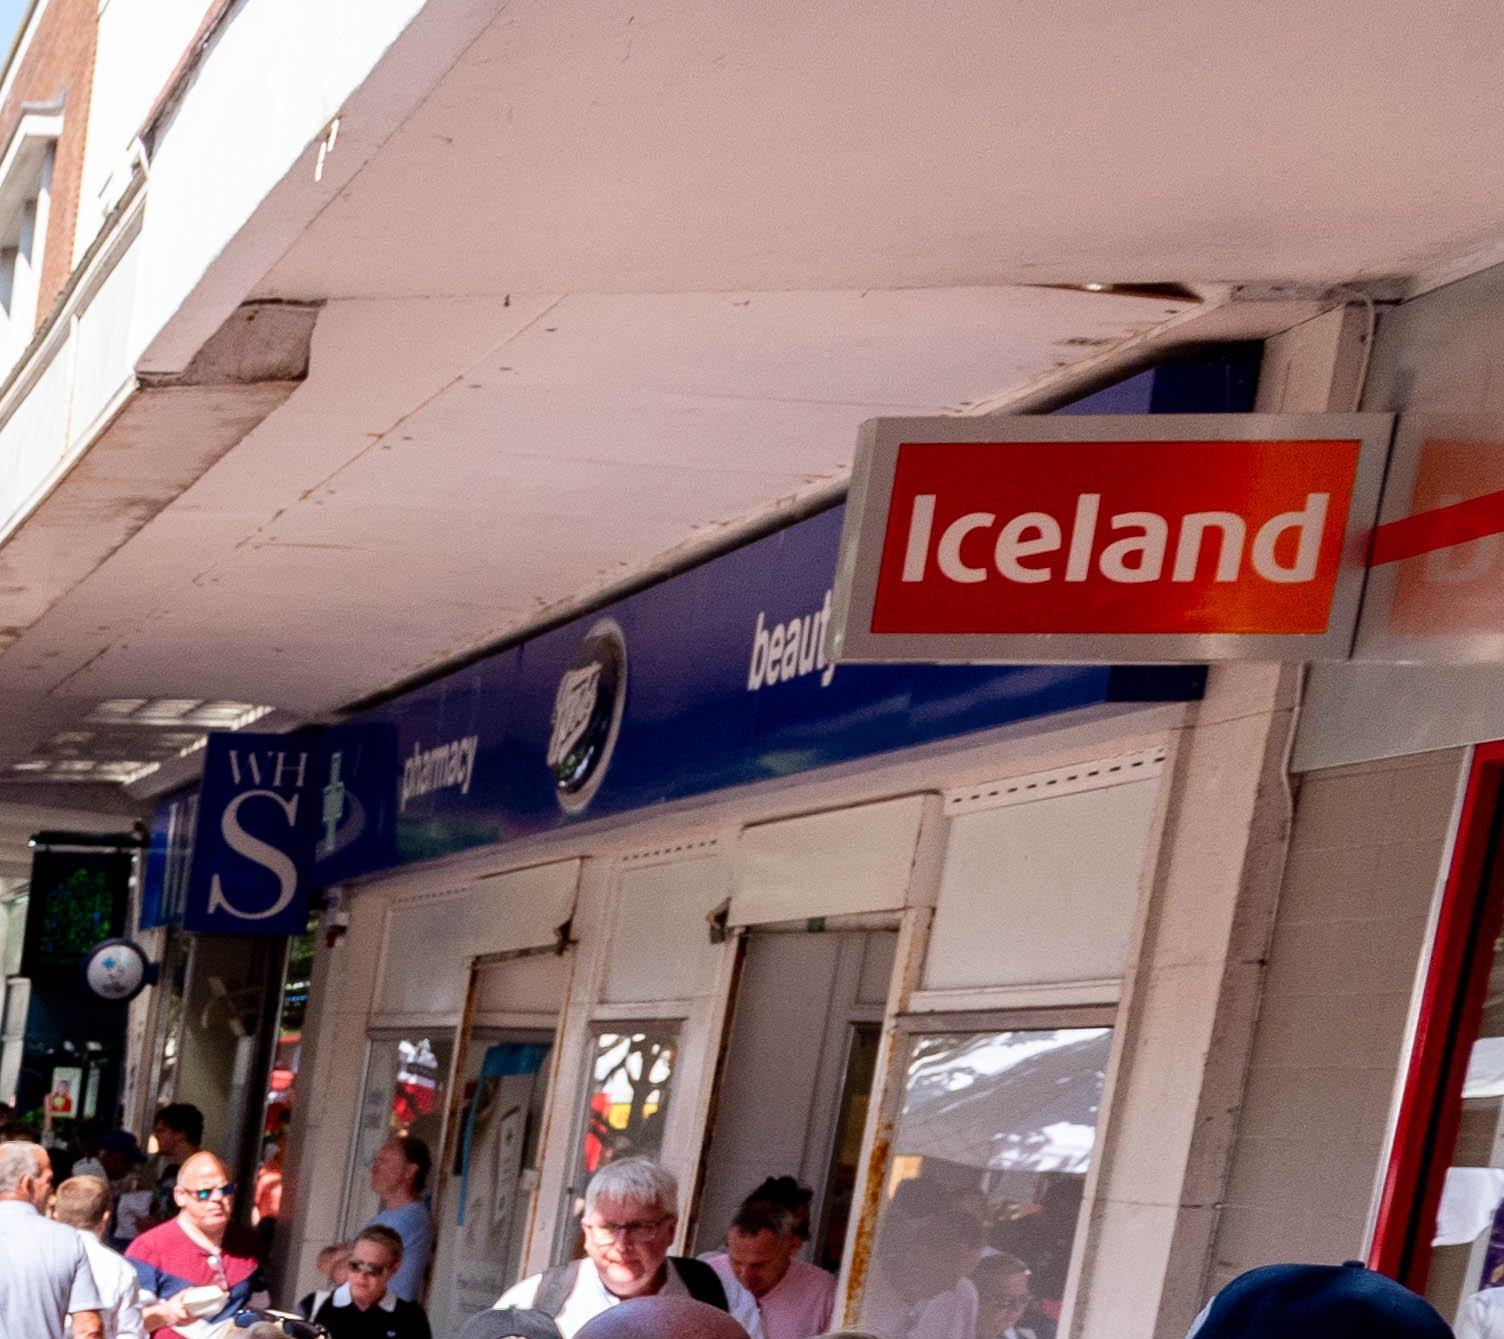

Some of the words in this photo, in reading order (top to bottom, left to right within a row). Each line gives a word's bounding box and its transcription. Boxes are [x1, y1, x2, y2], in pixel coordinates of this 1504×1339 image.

[901, 492, 1331, 585] Iceland
[228, 750, 308, 787] WH
[400, 734, 479, 812] pharmacy
